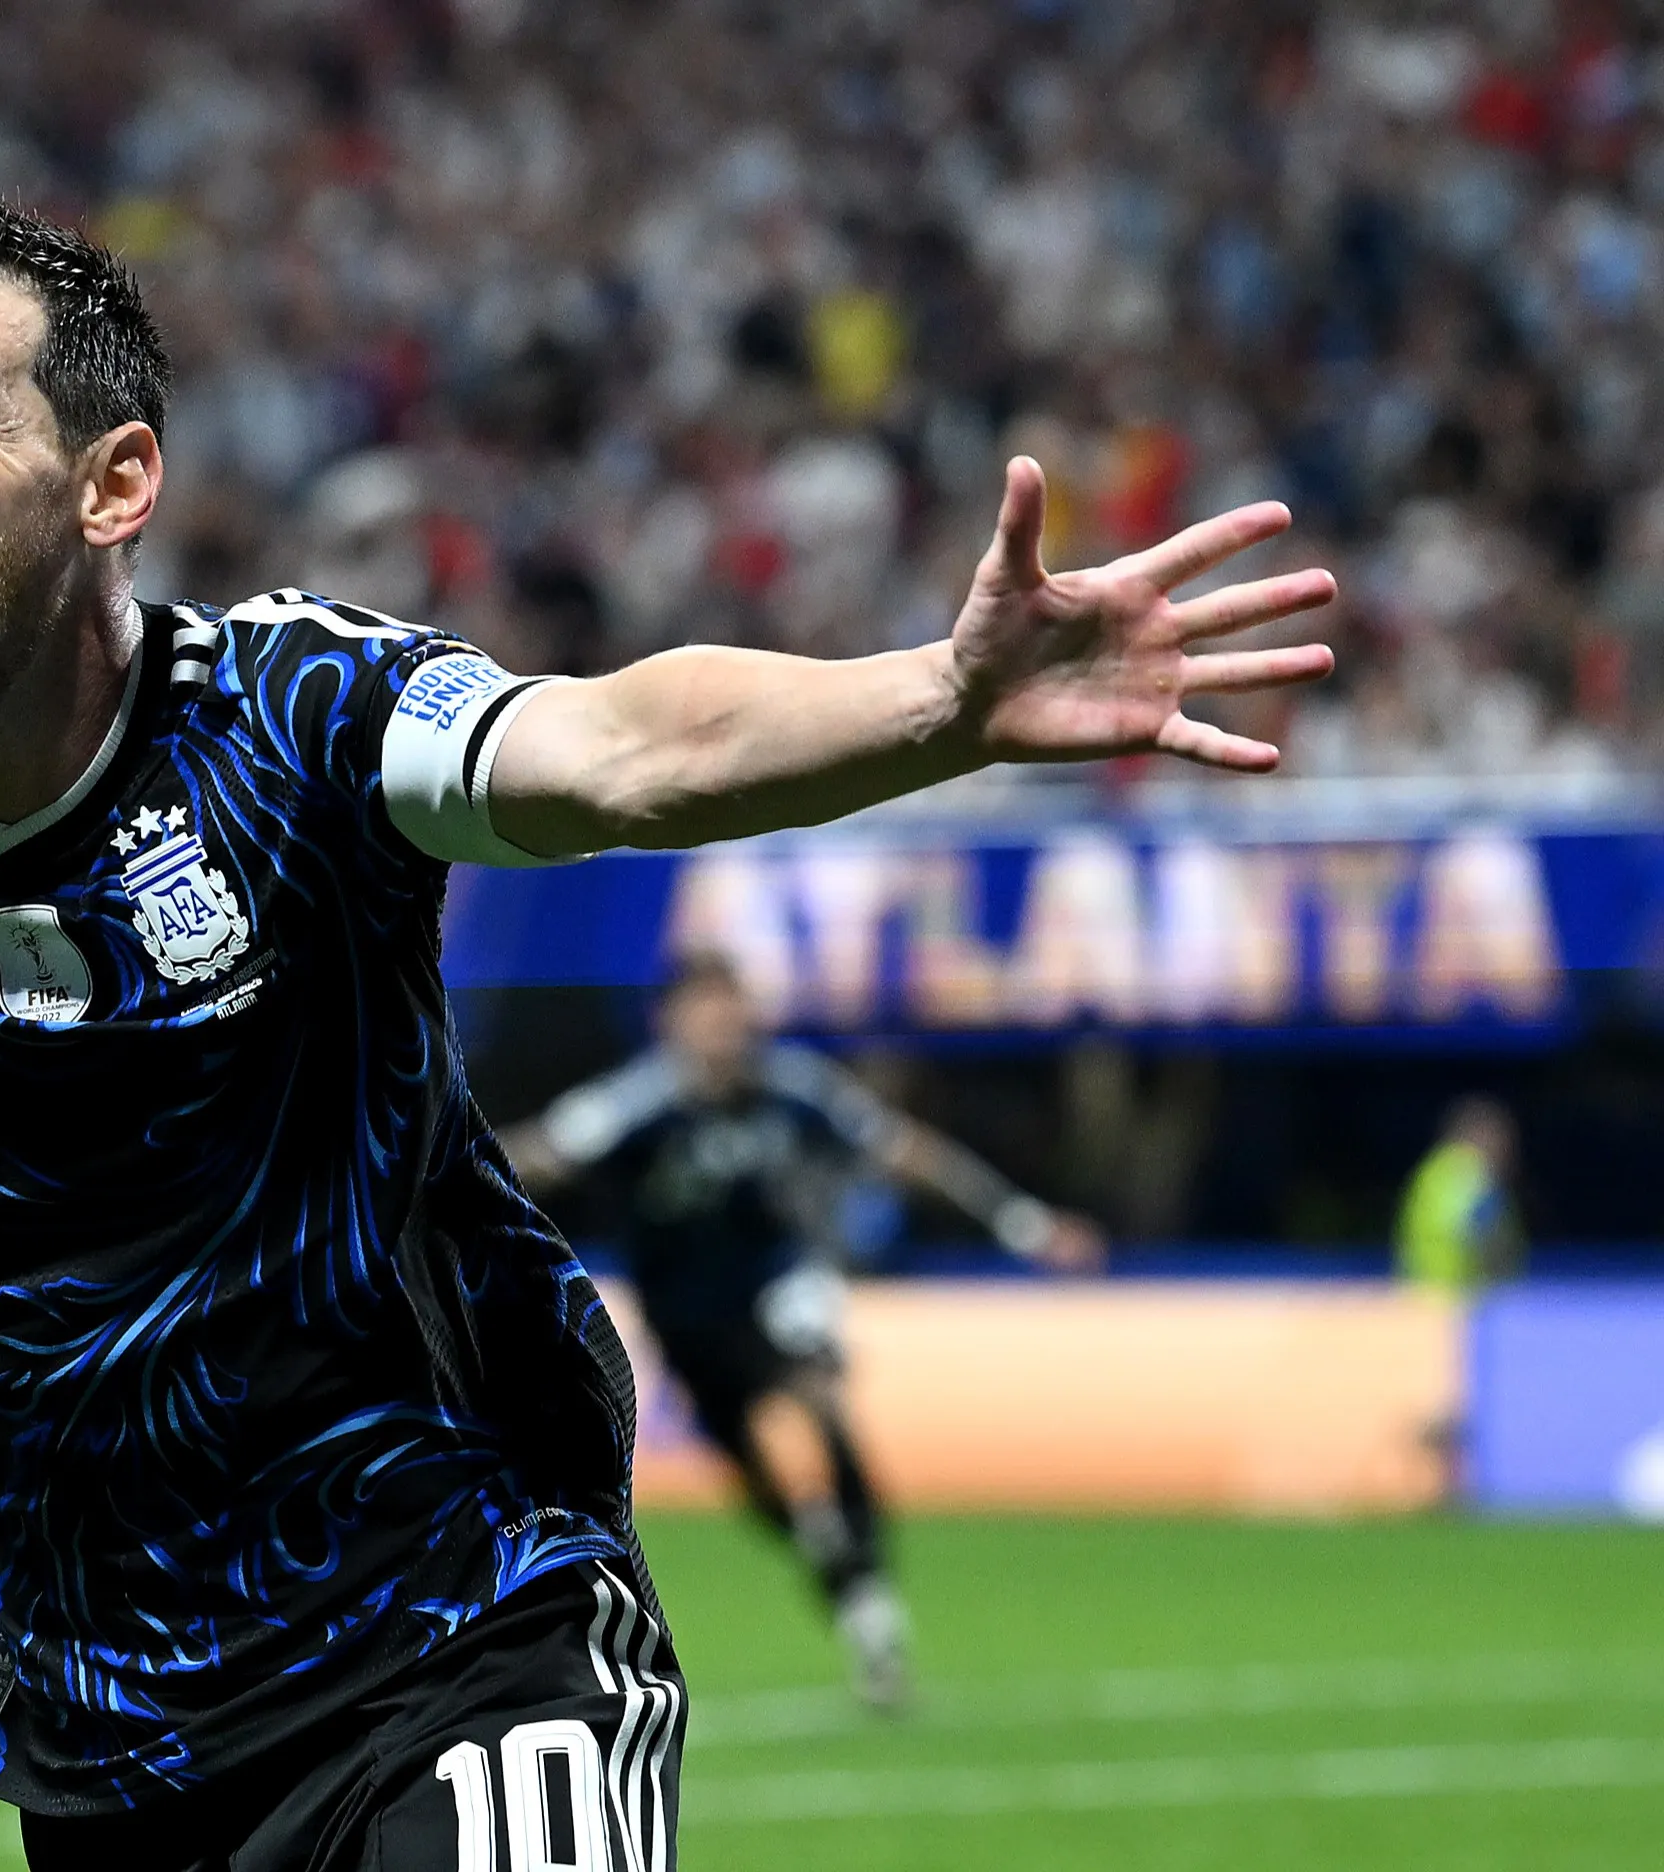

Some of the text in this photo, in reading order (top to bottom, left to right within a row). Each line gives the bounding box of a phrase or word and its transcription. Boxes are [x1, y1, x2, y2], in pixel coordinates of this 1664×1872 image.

[397, 658, 488, 716] FOOTBA
[415, 669, 504, 721] UNIT
[151, 876, 217, 942] AFA
[666, 832, 1566, 1028] ATLANTA
[233, 948, 277, 987] ARGENTINA
[16, 1002, 80, 1015] WORLD CHAMPIONS
[28, 986, 69, 1006] FIFA
[36, 1012, 61, 1022] 2022
[216, 992, 258, 1020] ATLANTA
[435, 1719, 616, 1872] 10
